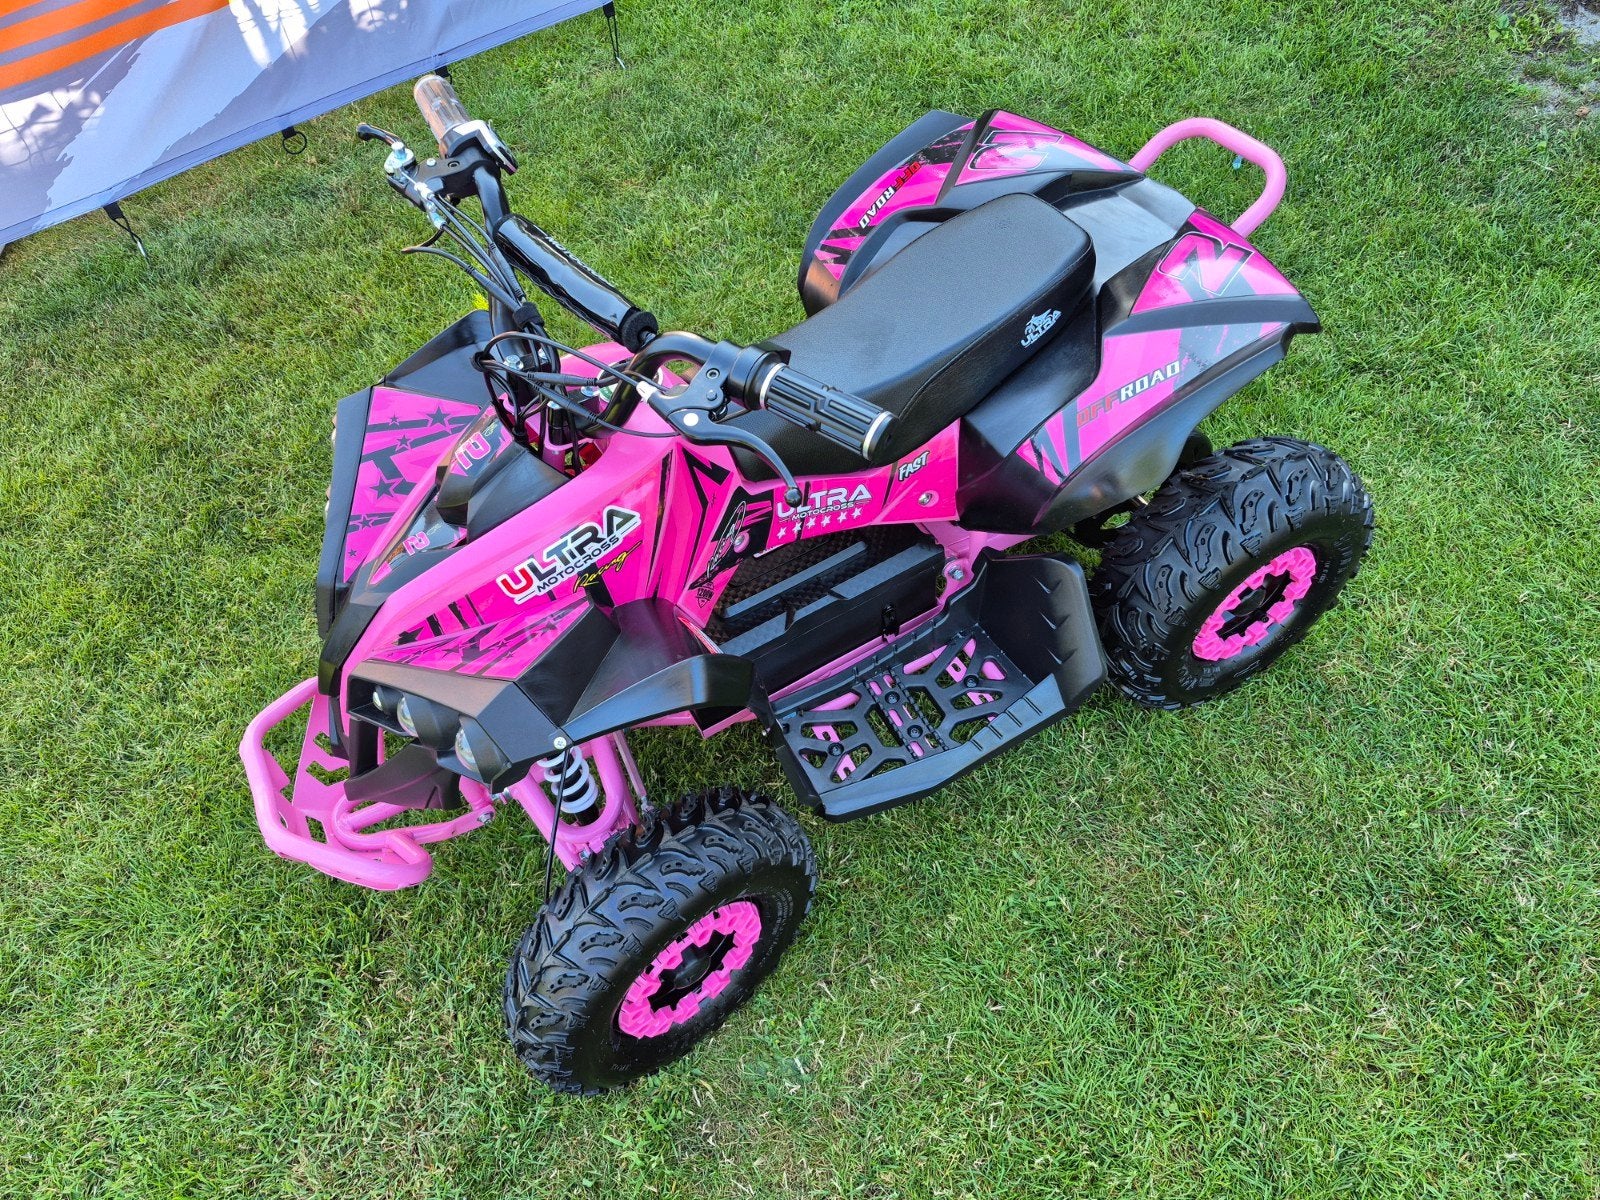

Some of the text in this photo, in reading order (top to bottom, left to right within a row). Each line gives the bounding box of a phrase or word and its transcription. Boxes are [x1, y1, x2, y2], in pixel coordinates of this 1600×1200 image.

[1021, 310, 1061, 348] ULTRA
[1076, 360, 1181, 428] OFFROAD
[898, 450, 930, 481] FAST
[792, 501, 854, 521] MOTOCROSS
[500, 508, 637, 595] ULTRA
[536, 534, 620, 593] MOTOCROSS
[572, 539, 643, 594] Racing
